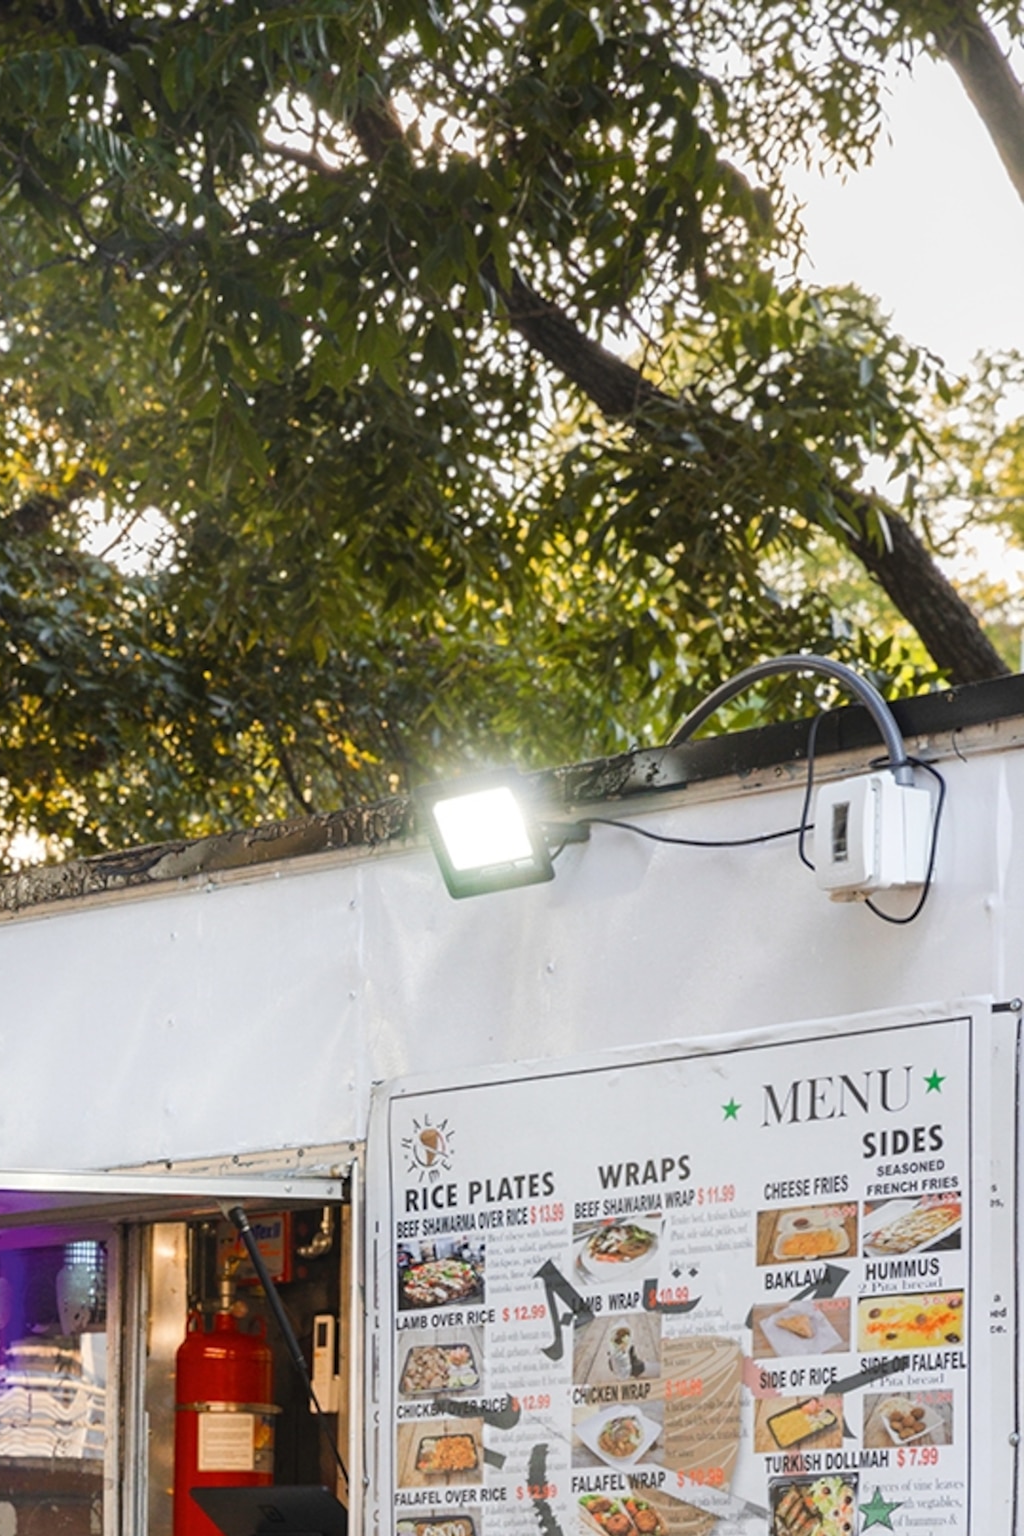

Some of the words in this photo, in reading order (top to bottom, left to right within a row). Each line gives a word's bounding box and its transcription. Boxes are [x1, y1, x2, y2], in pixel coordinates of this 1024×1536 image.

[760, 1066, 914, 1128] MENU
[862, 1124, 944, 1159] SIDES
[597, 1155, 691, 1189] WRAPS
[876, 1159, 945, 1177] SEASONED
[405, 1183, 458, 1212] RICE
[468, 1171, 555, 1205] PLATES
[764, 1178, 810, 1200] CHEESE
[813, 1174, 849, 1194] FRIES
[866, 1179, 918, 1197] FRENCH
[922, 1176, 959, 1191] FRIES
[574, 1201, 600, 1219] BEEF
[603, 1193, 662, 1216] SHAWARMA
[665, 1189, 695, 1209] WRAP
[707, 1184, 735, 1204] 11.99
[397, 1220, 420, 1239] BEEF
[422, 1213, 476, 1236] SHAWARMA
[478, 1210, 504, 1230] OVER
[506, 1207, 528, 1226] RICE
[765, 1268, 832, 1291] BAKLAVA
[866, 1258, 940, 1281] HUMMUS
[608, 1291, 640, 1311] WRAP
[396, 1314, 428, 1331] LAMB
[431, 1311, 464, 1329] OVER
[467, 1309, 495, 1325] RICE
[514, 1304, 546, 1321] 12.99
[861, 1355, 890, 1375] SIDE
[912, 1351, 966, 1371] FALAFEL
[760, 1370, 786, 1389] SIDE
[790, 1368, 805, 1387] OF
[810, 1366, 838, 1385] RICE
[480, 1397, 507, 1413] RICE
[522, 1394, 550, 1410] 12.99
[573, 1385, 619, 1406] CHICKEN
[621, 1382, 651, 1400] WRAP
[765, 1453, 821, 1474] TURKISH
[825, 1449, 889, 1470] DOLLMAH
[897, 1448, 905, 1467] $
[909, 1447, 939, 1466] 7.99
[571, 1474, 625, 1493] FALAFEL
[628, 1472, 666, 1490] WRAP
[394, 1490, 442, 1507] FALAFEL
[445, 1488, 477, 1504] OVER
[480, 1487, 507, 1502] RICE
